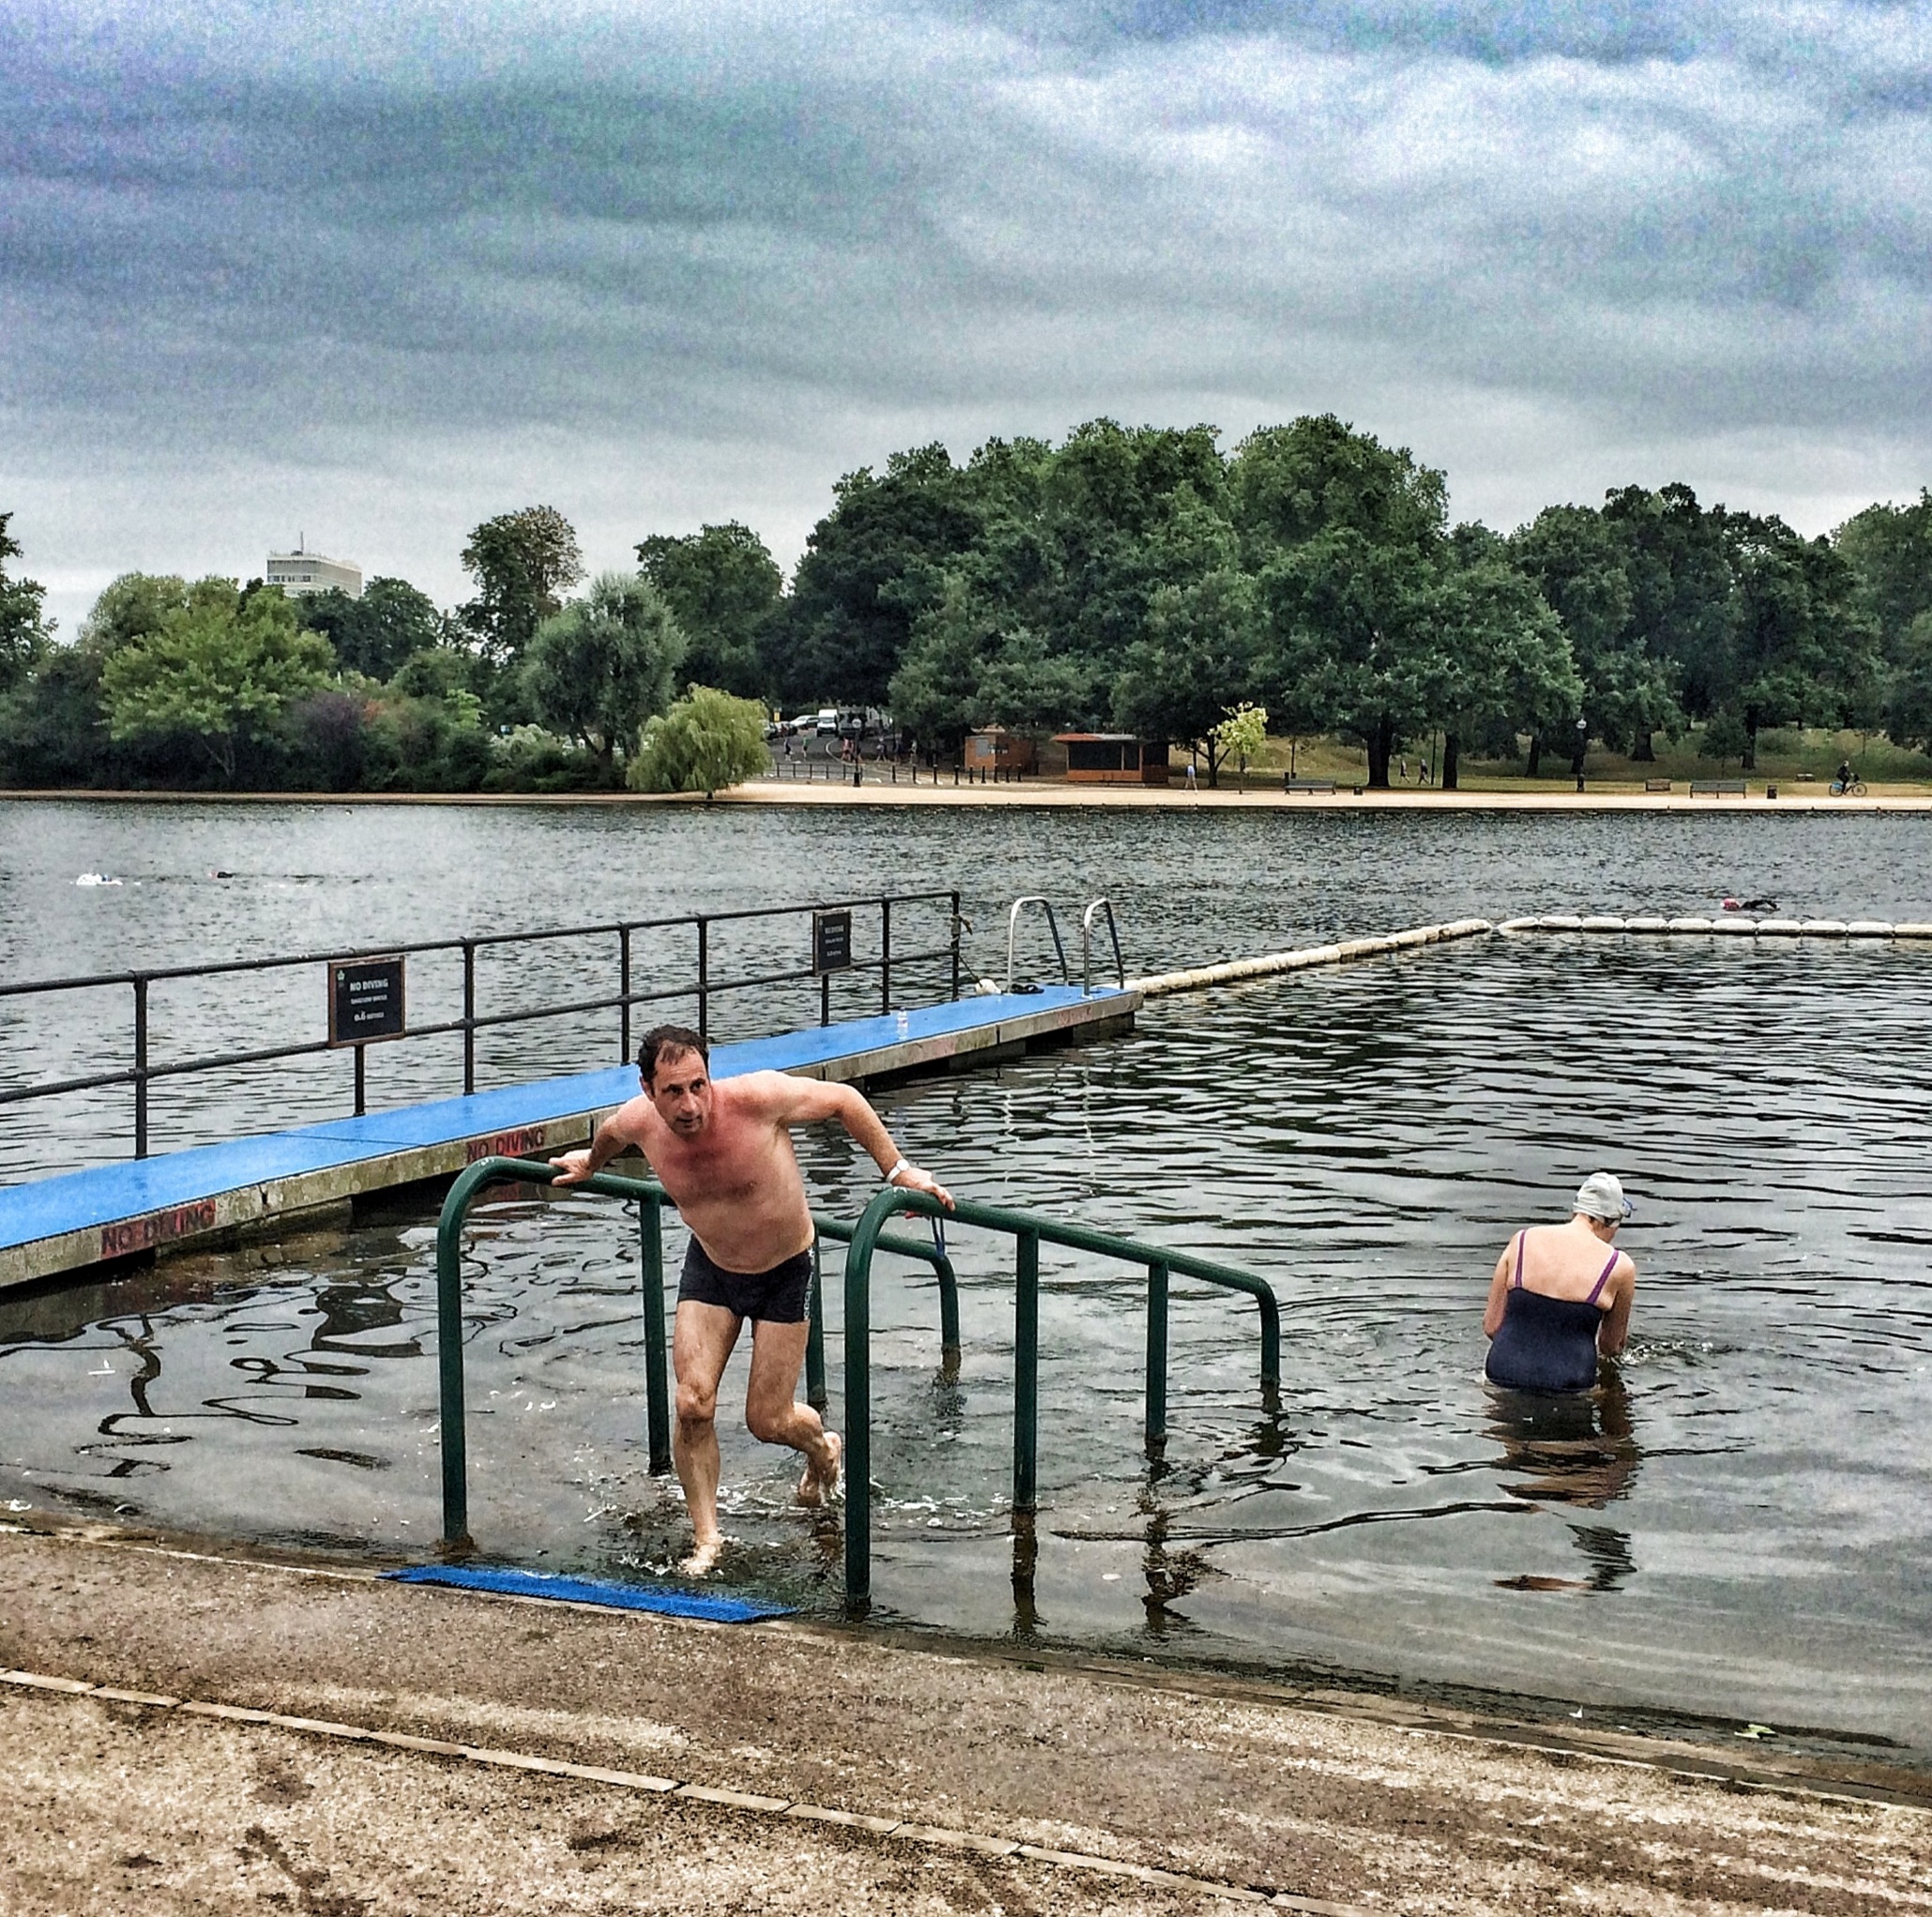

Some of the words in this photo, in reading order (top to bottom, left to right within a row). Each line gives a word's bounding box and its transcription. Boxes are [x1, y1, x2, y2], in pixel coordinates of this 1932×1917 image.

[350, 981, 362, 991] NO
[362, 978, 389, 990] DIVING
[467, 1140, 489, 1163] NO
